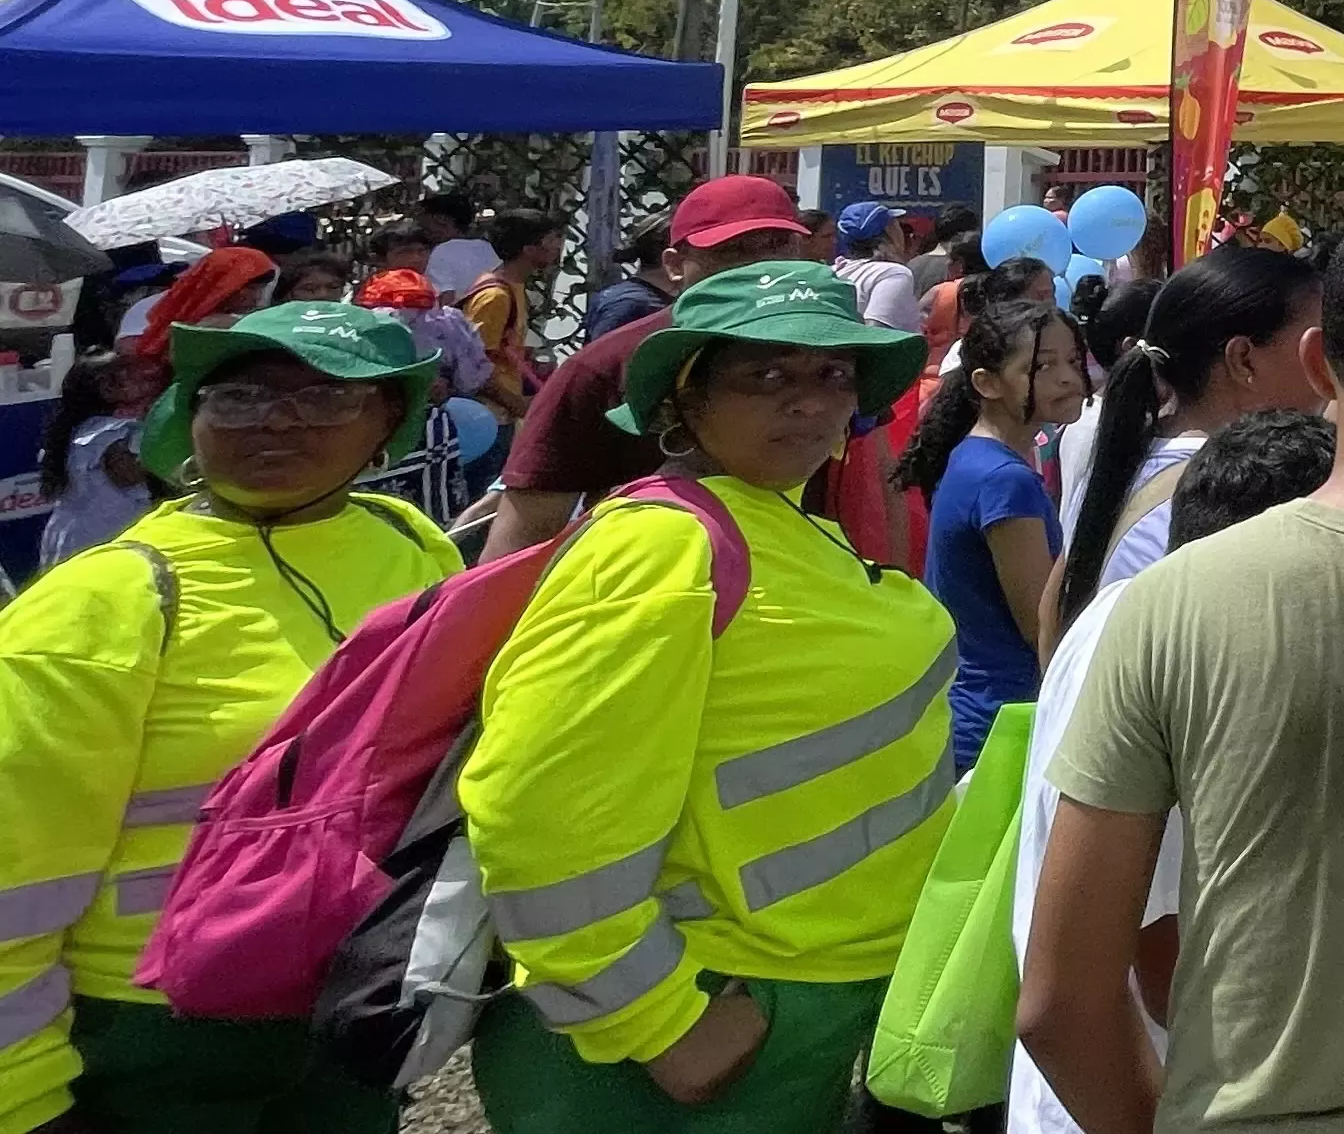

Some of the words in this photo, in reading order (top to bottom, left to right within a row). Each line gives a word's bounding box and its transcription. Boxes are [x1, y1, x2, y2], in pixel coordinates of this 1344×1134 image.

[856, 143, 873, 165] EL
[879, 142, 955, 165] KETCHUP
[868, 166, 911, 197] QUE
[917, 166, 942, 197] ES
